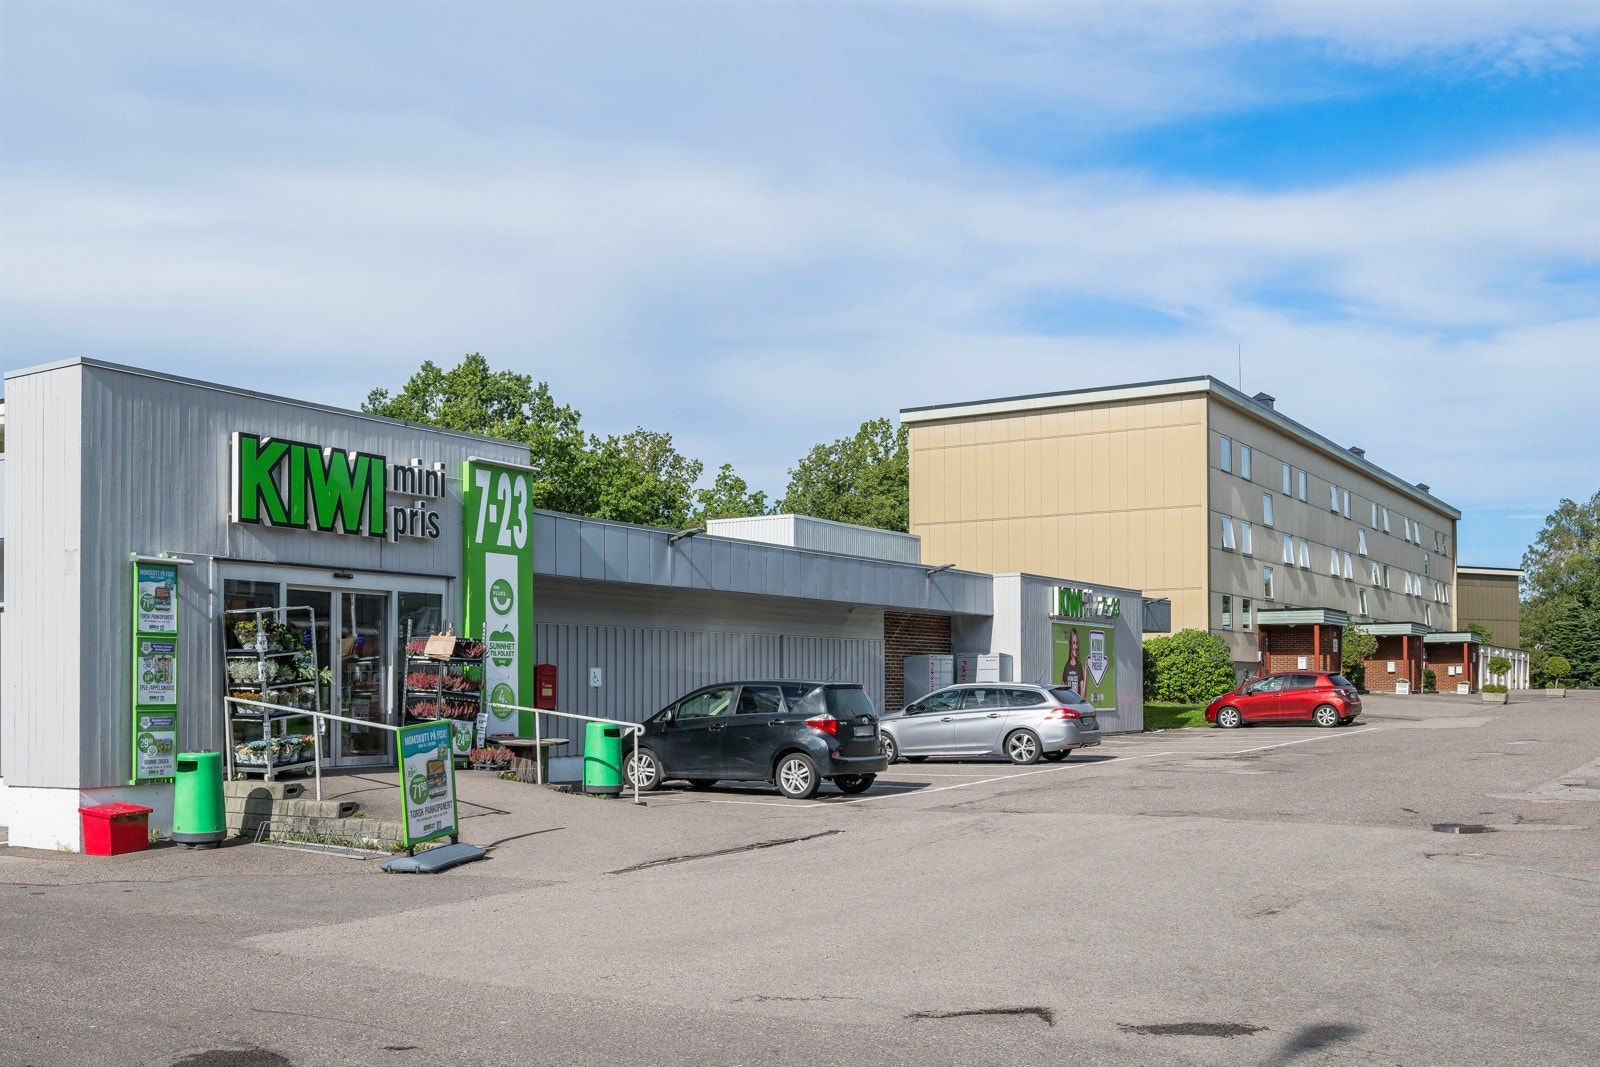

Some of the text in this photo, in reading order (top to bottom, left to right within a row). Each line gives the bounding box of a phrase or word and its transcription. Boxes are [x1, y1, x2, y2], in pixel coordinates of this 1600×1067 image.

[236, 433, 387, 538] KIWI
[393, 458, 446, 498] mini
[393, 503, 441, 543] pris
[475, 468, 528, 549] 7-23
[489, 642, 515, 651] SUNNHET
[498, 650, 515, 658] FOLKET
[410, 807, 425, 819] TORSK
[424, 800, 453, 816] PANKOPANERT
